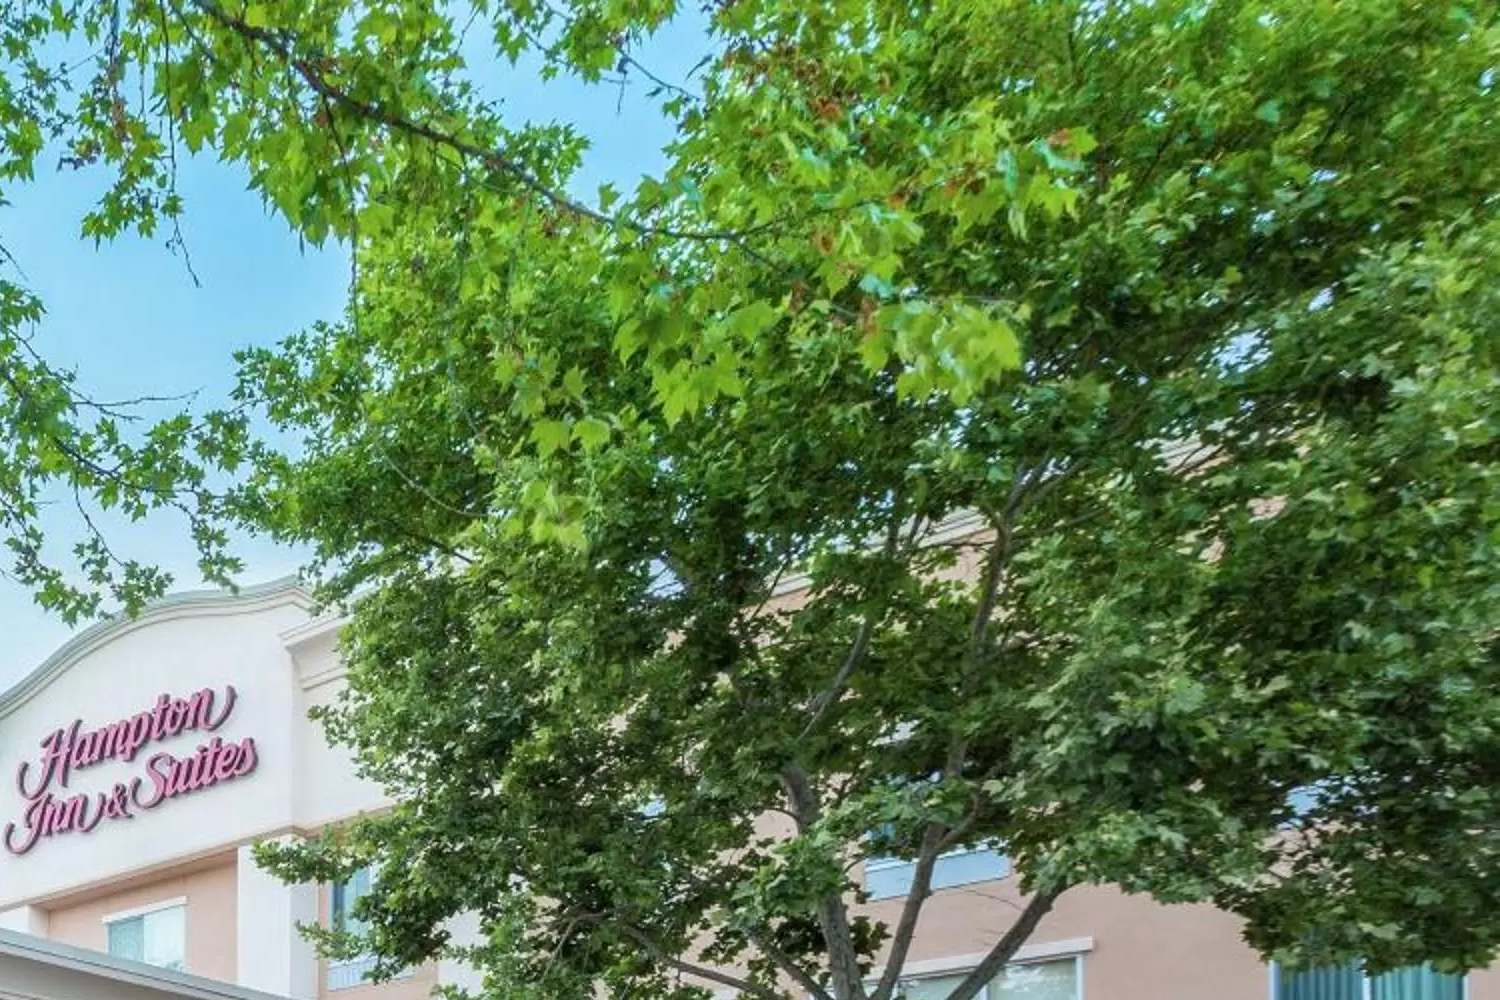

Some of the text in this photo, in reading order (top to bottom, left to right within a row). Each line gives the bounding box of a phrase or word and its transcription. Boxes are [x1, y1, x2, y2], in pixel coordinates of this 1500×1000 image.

[4, 736, 259, 855] Inn & Suites
[16, 684, 238, 801] Hampton
